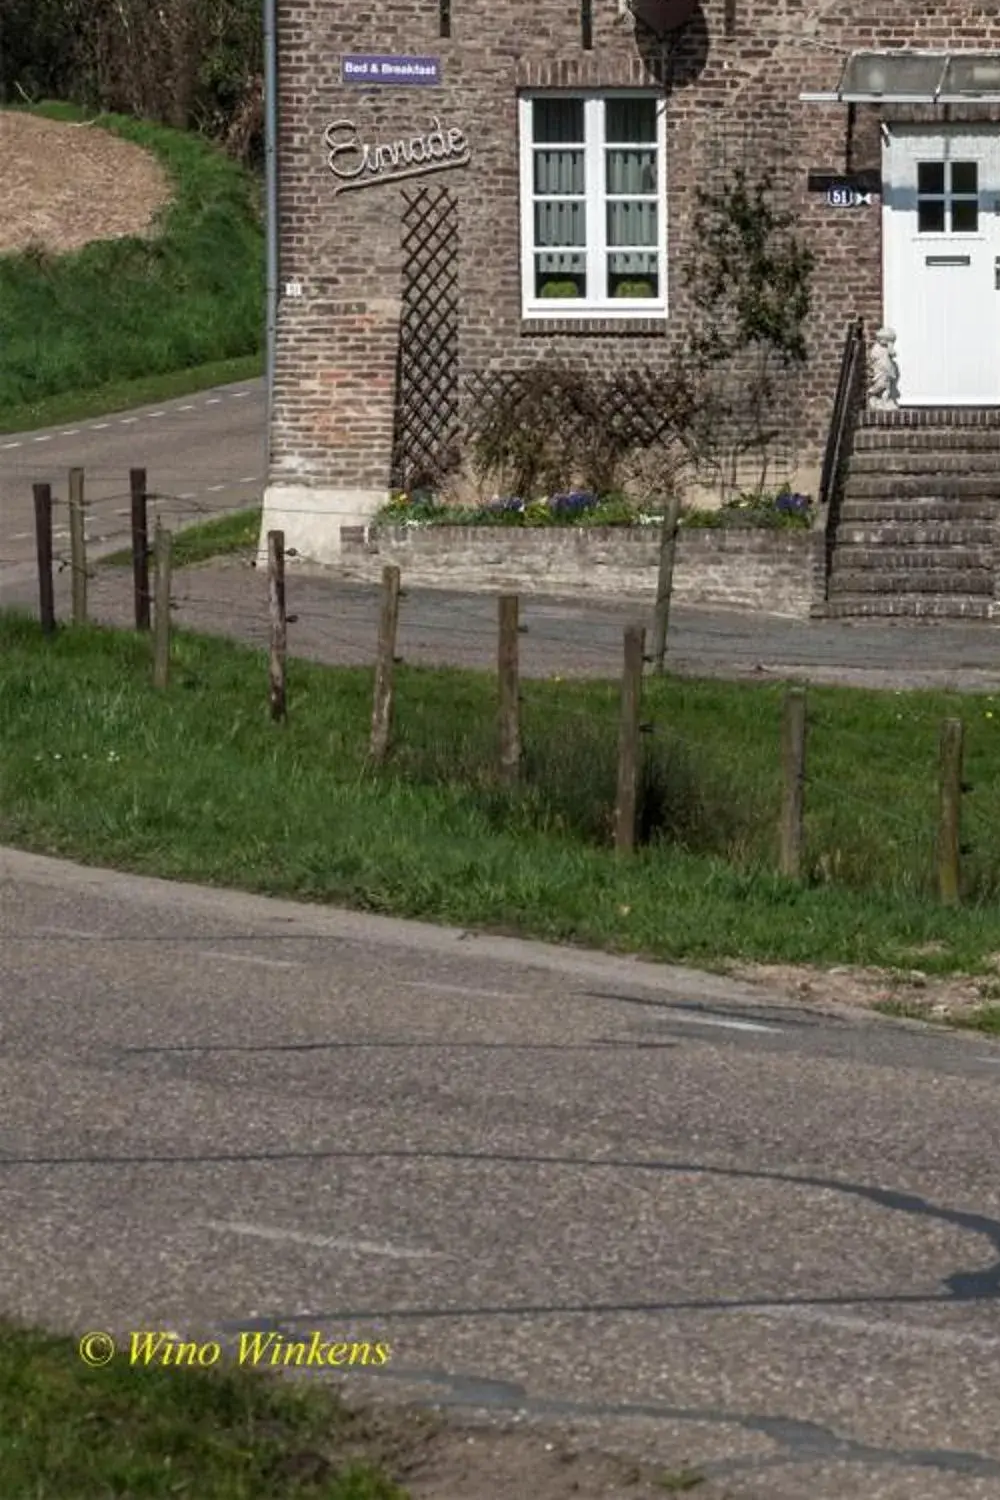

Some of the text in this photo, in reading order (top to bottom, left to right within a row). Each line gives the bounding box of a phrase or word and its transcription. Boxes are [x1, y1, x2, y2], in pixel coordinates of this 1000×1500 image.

[345, 61, 436, 75] Bed & Breakfast
[833, 190, 847, 203] 51
